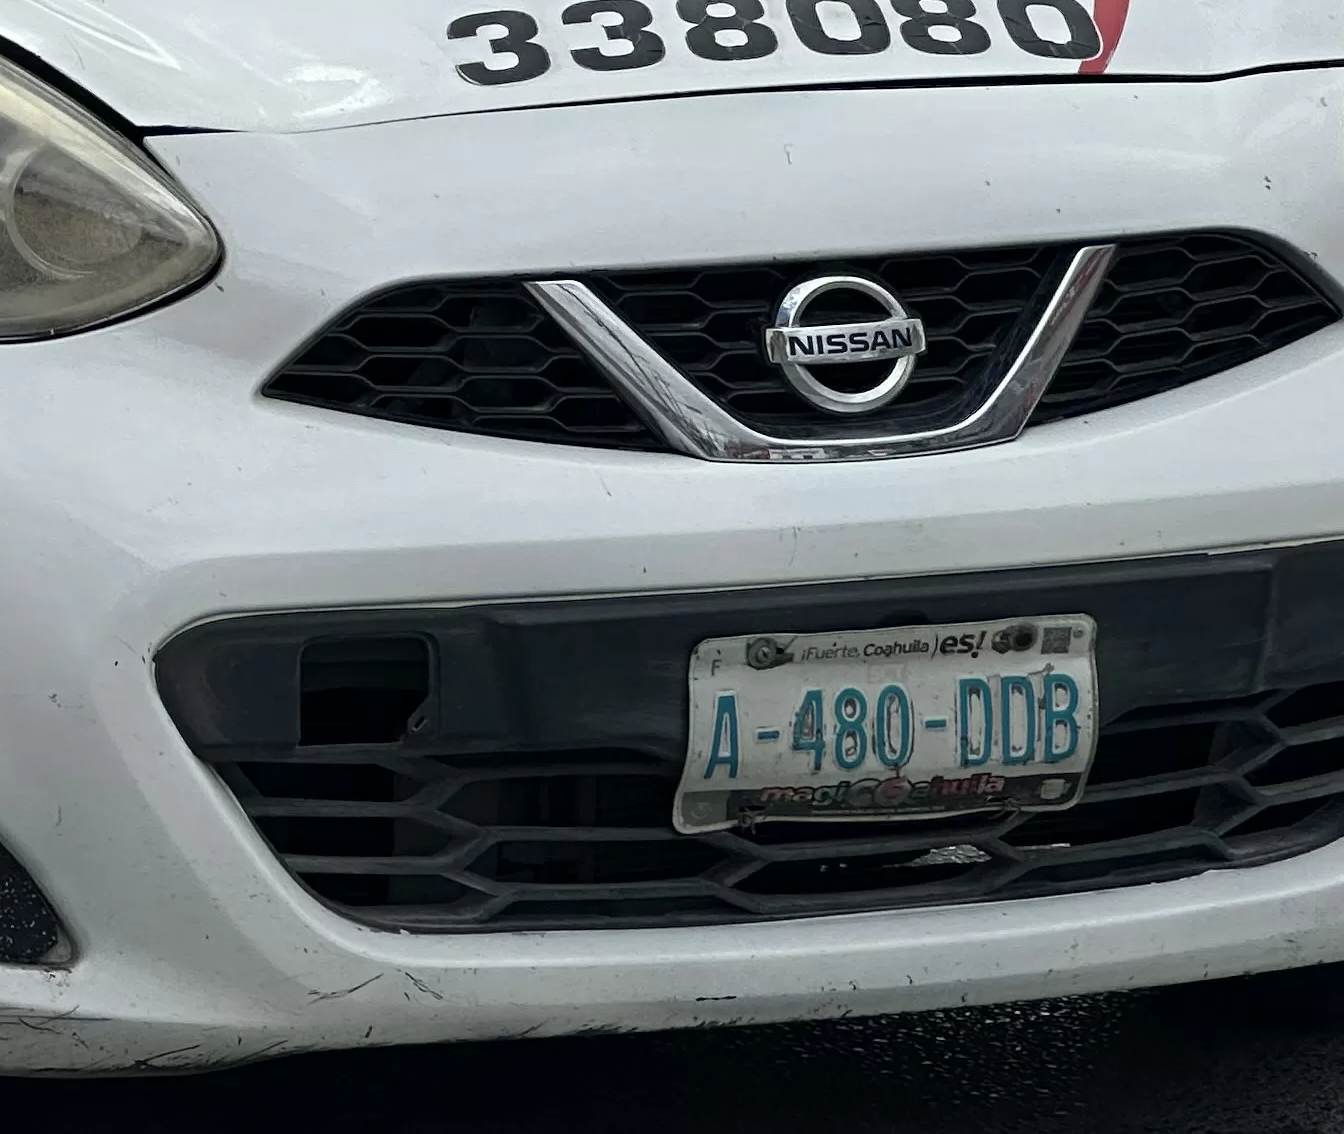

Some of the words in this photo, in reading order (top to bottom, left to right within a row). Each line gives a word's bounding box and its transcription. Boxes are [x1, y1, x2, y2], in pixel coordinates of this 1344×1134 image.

[787, 326, 913, 356] NISSAN
[863, 640, 930, 658] Coahuila
[703, 672, 1081, 781] A-480-DDB
